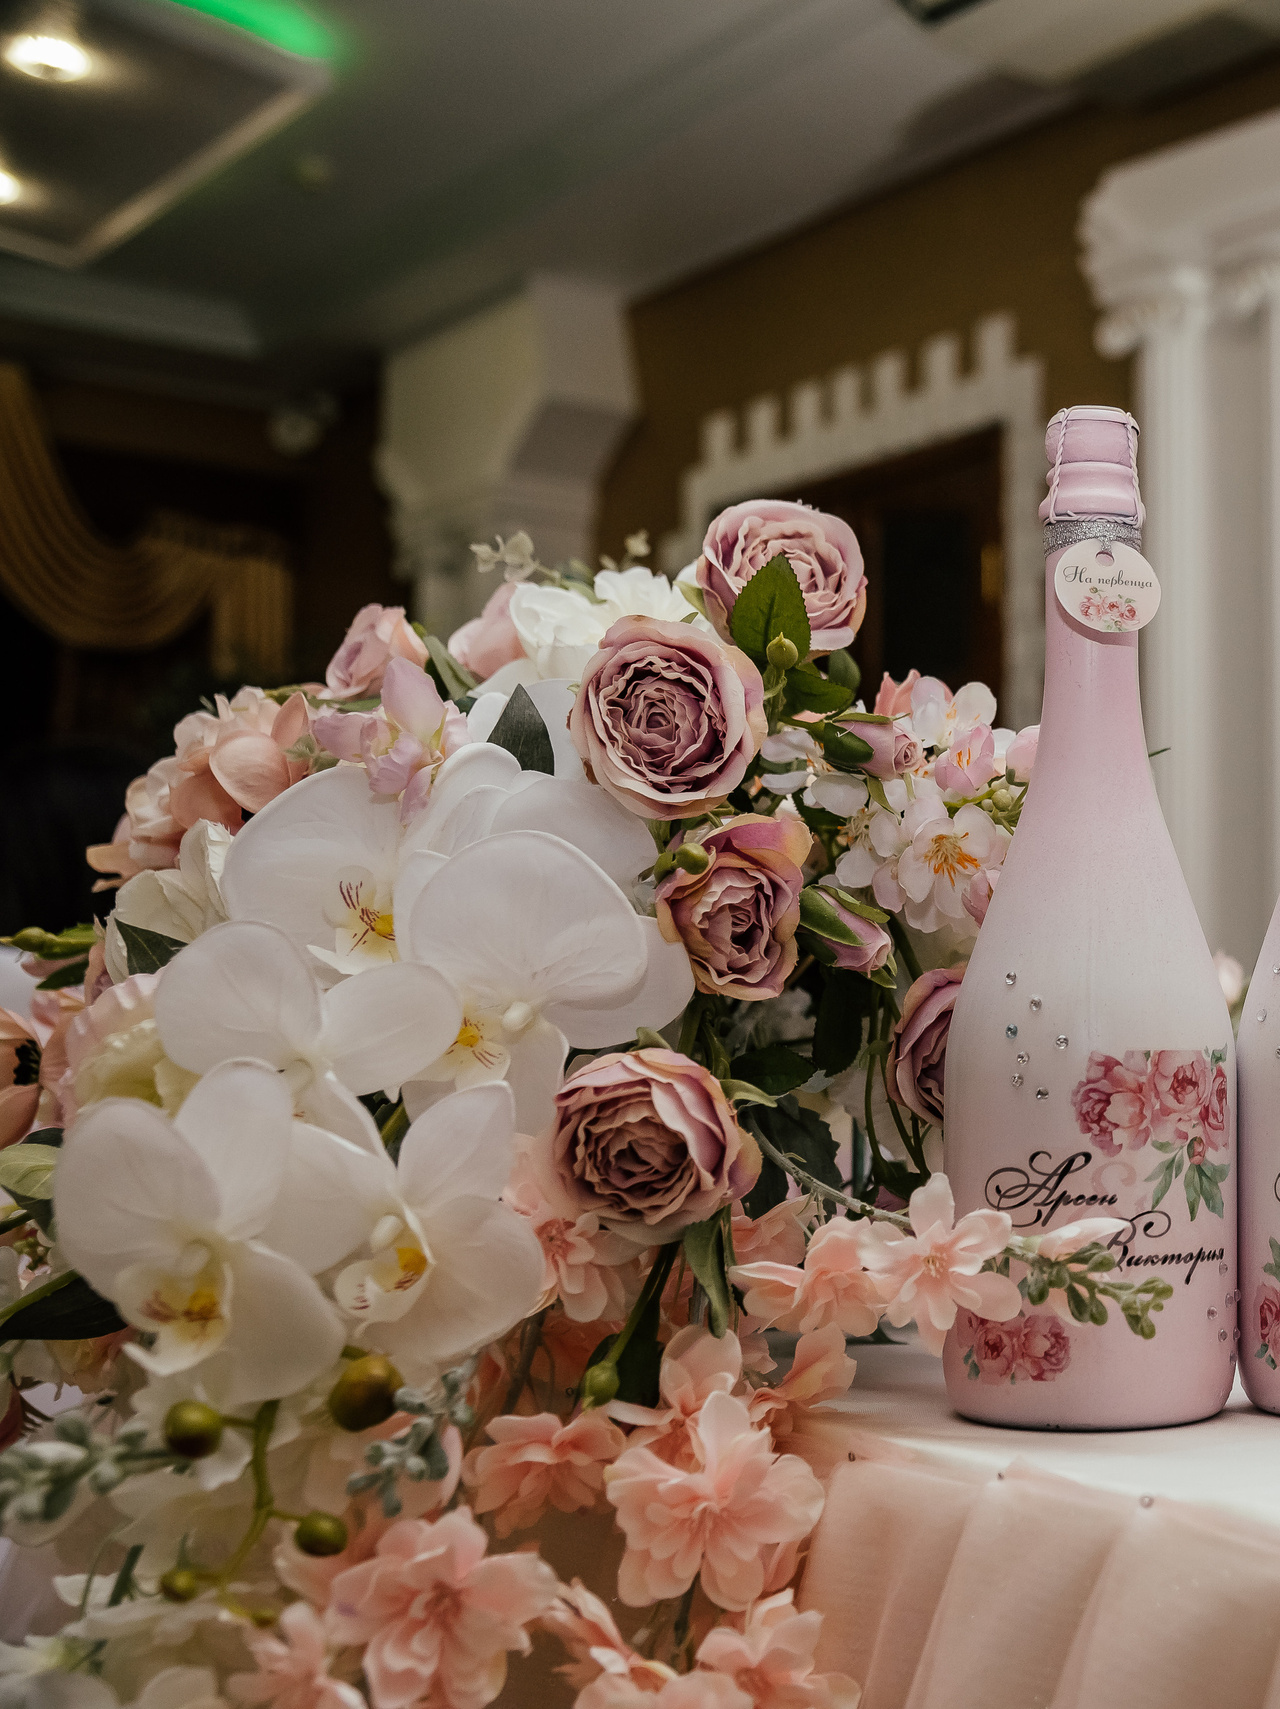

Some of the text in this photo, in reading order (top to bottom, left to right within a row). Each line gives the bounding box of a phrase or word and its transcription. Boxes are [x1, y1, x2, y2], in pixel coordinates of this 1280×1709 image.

[1063, 565, 1153, 589] На первенца
[985, 1150, 1118, 1227] Арсен
